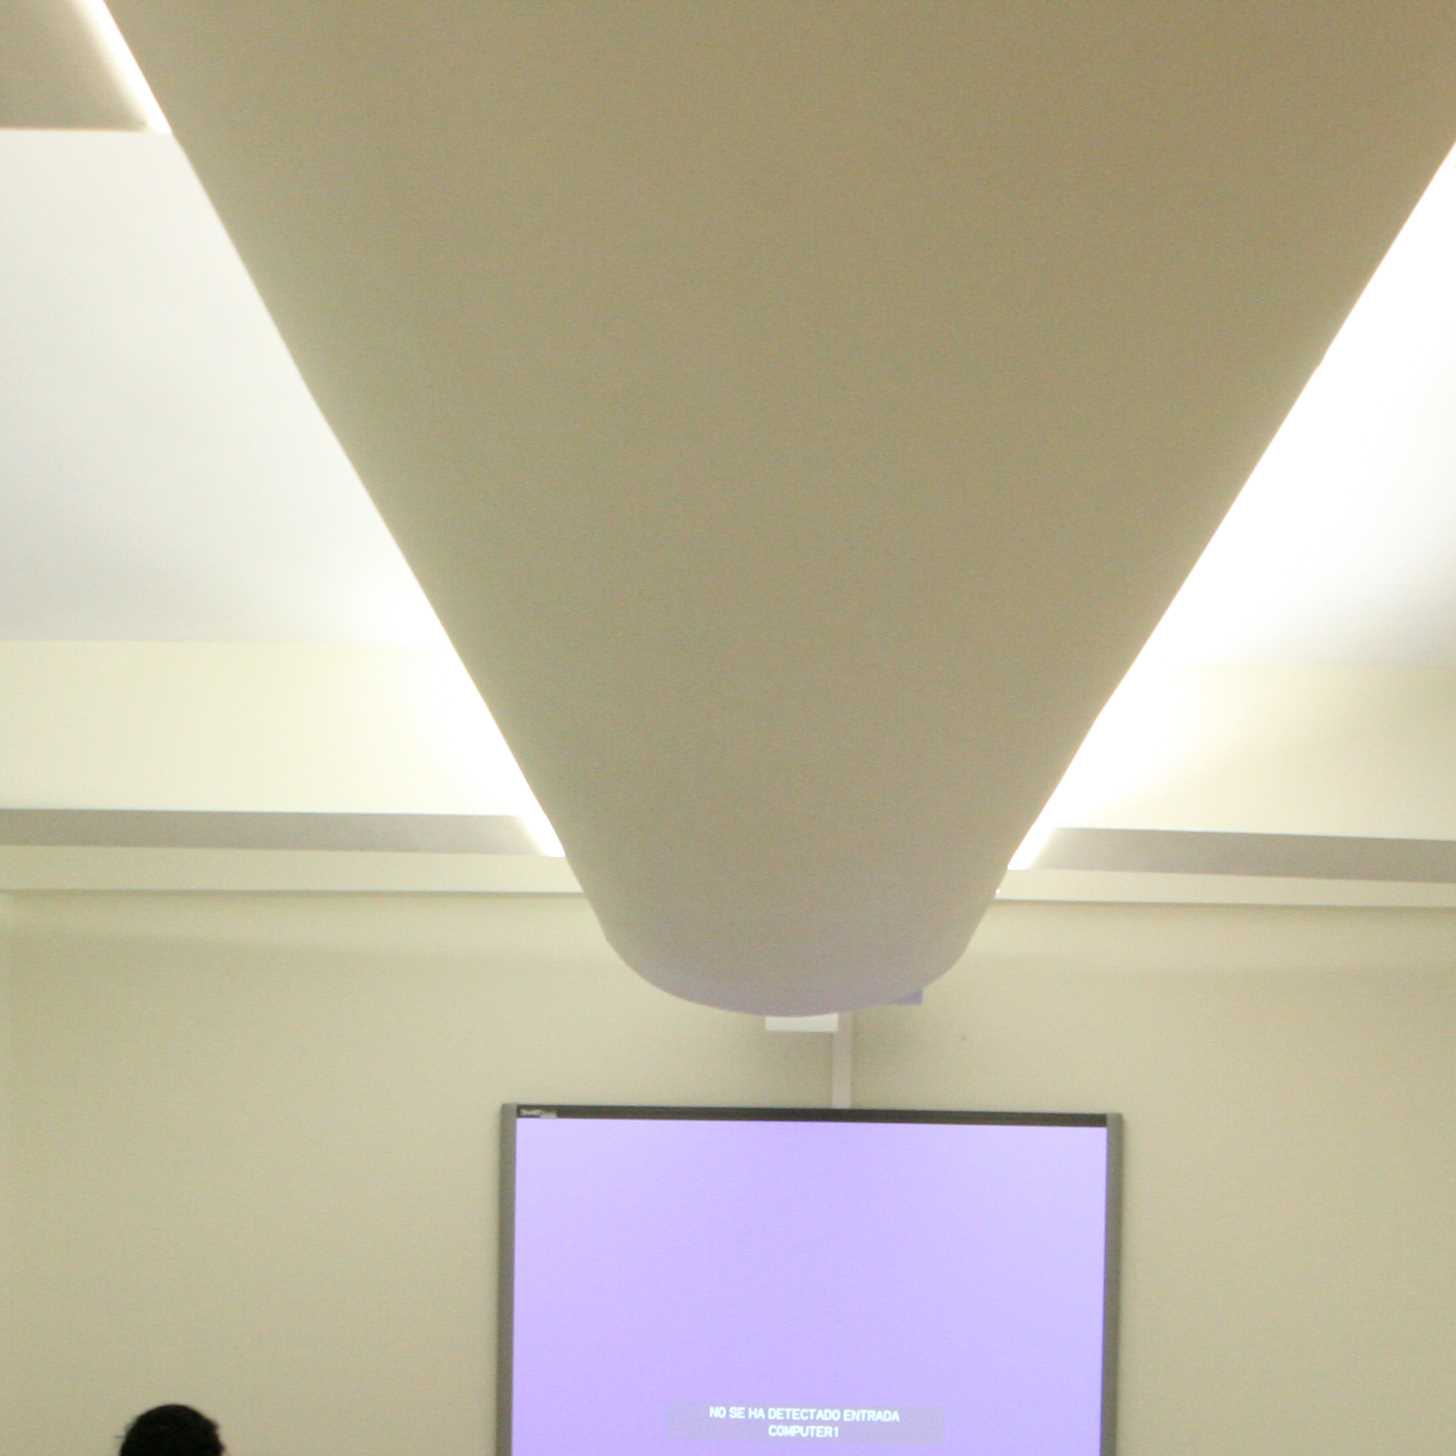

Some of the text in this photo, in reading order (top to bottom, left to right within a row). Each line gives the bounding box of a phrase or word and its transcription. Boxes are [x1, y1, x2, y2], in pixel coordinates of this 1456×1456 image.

[709, 1406, 900, 1423] NO SE HA DETECTADO ENTRADA
